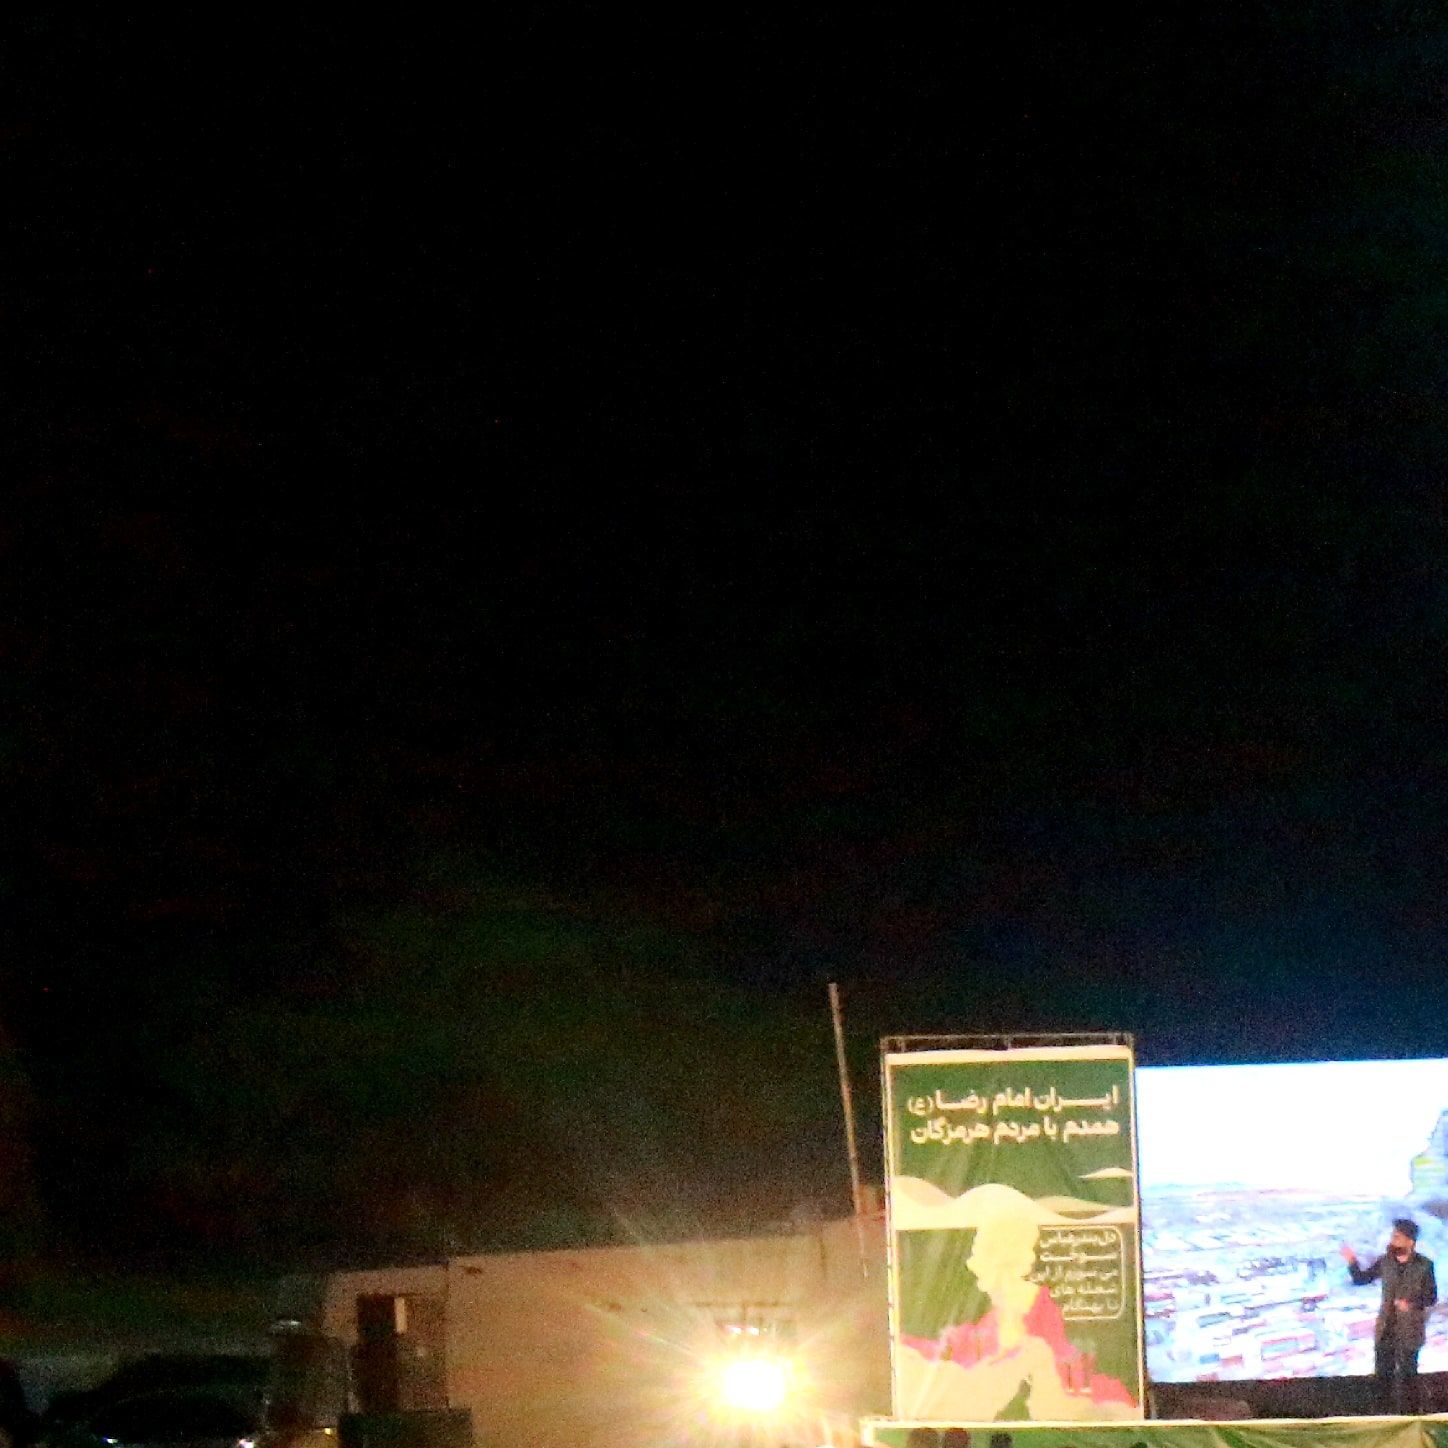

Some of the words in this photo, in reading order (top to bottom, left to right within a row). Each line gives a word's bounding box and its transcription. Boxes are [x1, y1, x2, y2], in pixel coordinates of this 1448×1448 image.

[993, 1086, 1031, 1116] امام
[1033, 1084, 1119, 1112] ایران
[911, 1116, 991, 1145] هرمزگان
[993, 1121, 1041, 1145] مردم
[1043, 1115, 1059, 1140] با
